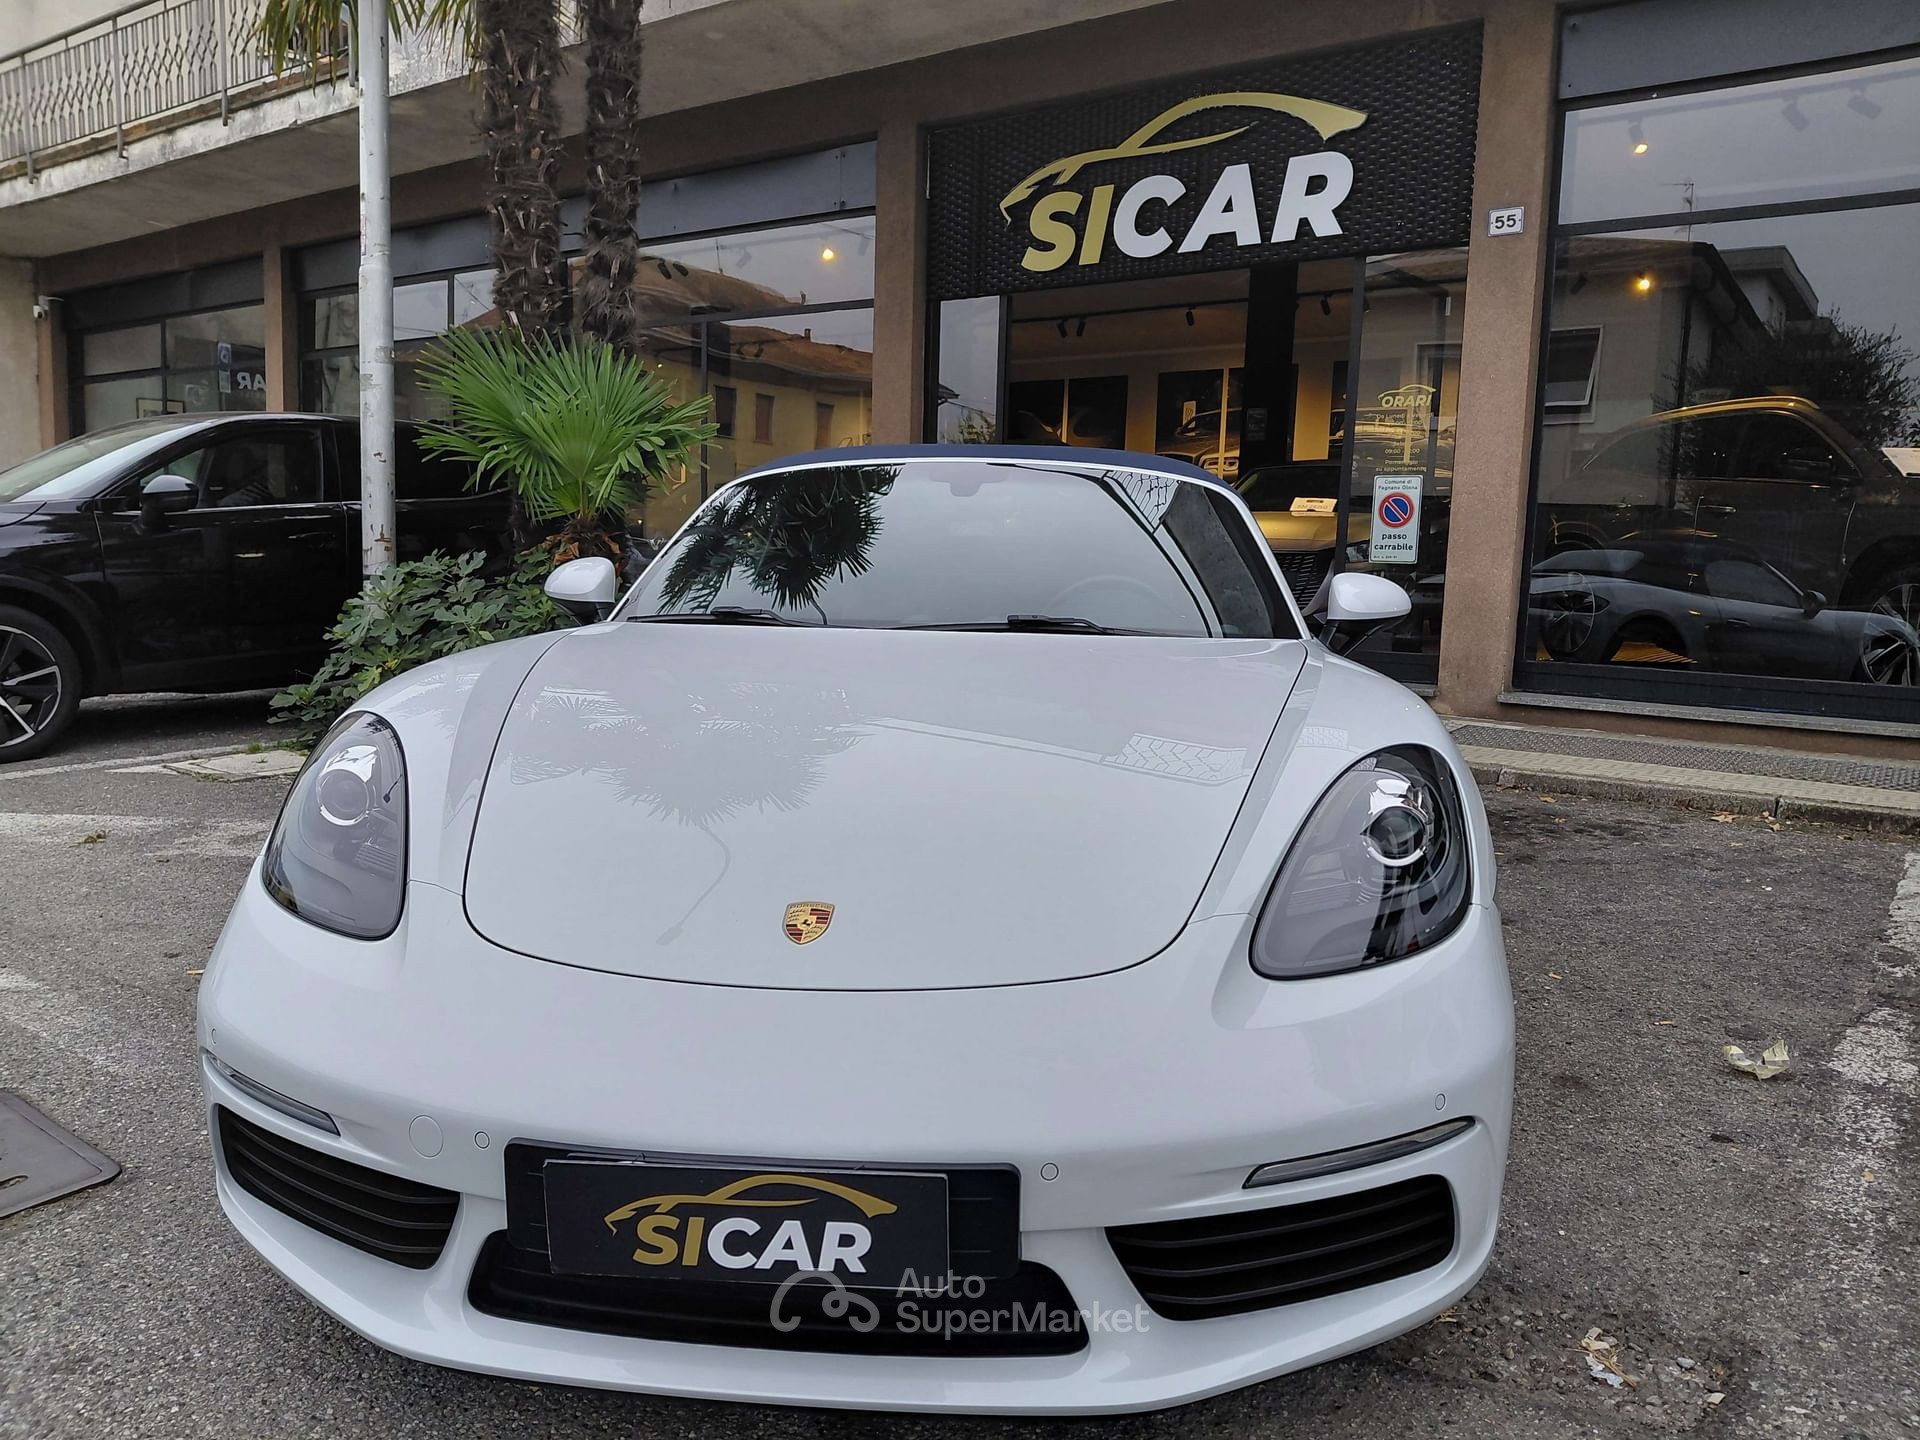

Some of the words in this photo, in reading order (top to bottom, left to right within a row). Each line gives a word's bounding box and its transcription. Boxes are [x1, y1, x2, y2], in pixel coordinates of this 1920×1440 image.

[1020, 151, 1354, 272] SICAR
[1495, 214, 1516, 229] 55
[1381, 395, 1431, 407] ORARI
[1382, 533, 1407, 541] passo
[1374, 543, 1413, 551] carrabile
[632, 1215, 872, 1273] SICAR
